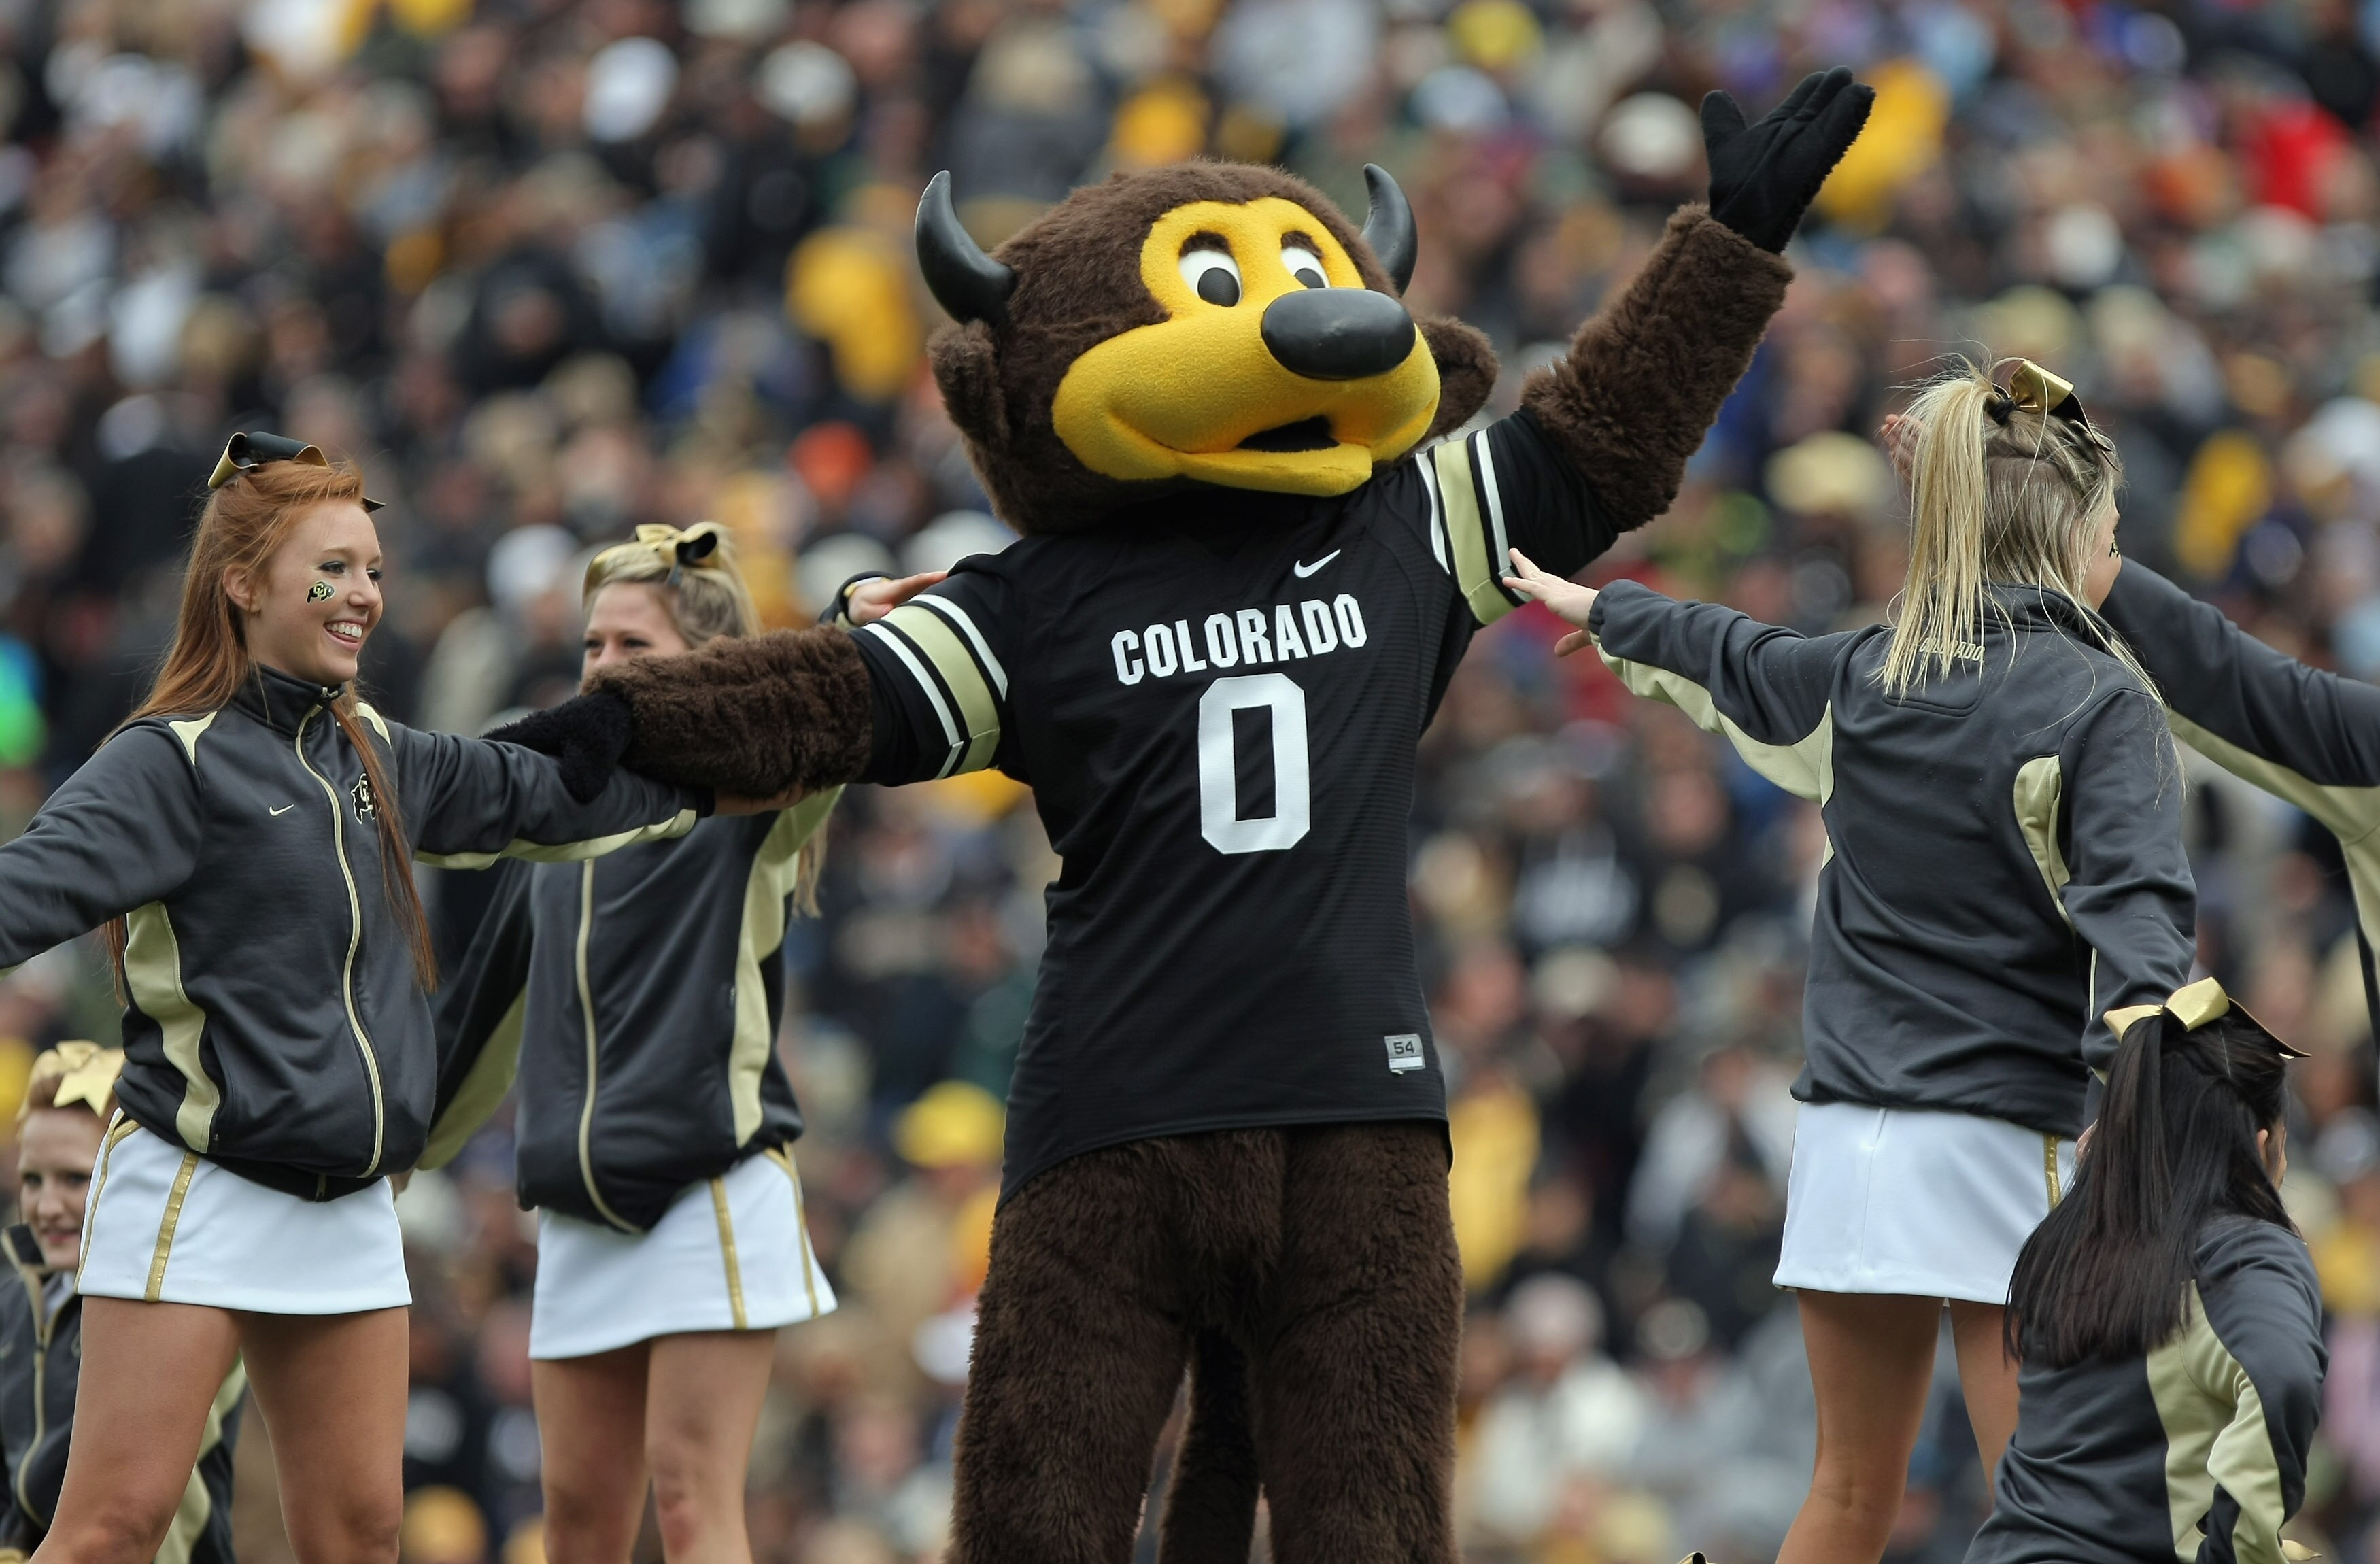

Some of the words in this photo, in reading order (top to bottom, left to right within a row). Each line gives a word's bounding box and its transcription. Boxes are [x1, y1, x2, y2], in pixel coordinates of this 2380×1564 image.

[1111, 594, 1367, 685] COLORADO
[1198, 673, 1310, 855] 0
[1393, 1041, 1414, 1055] 54
